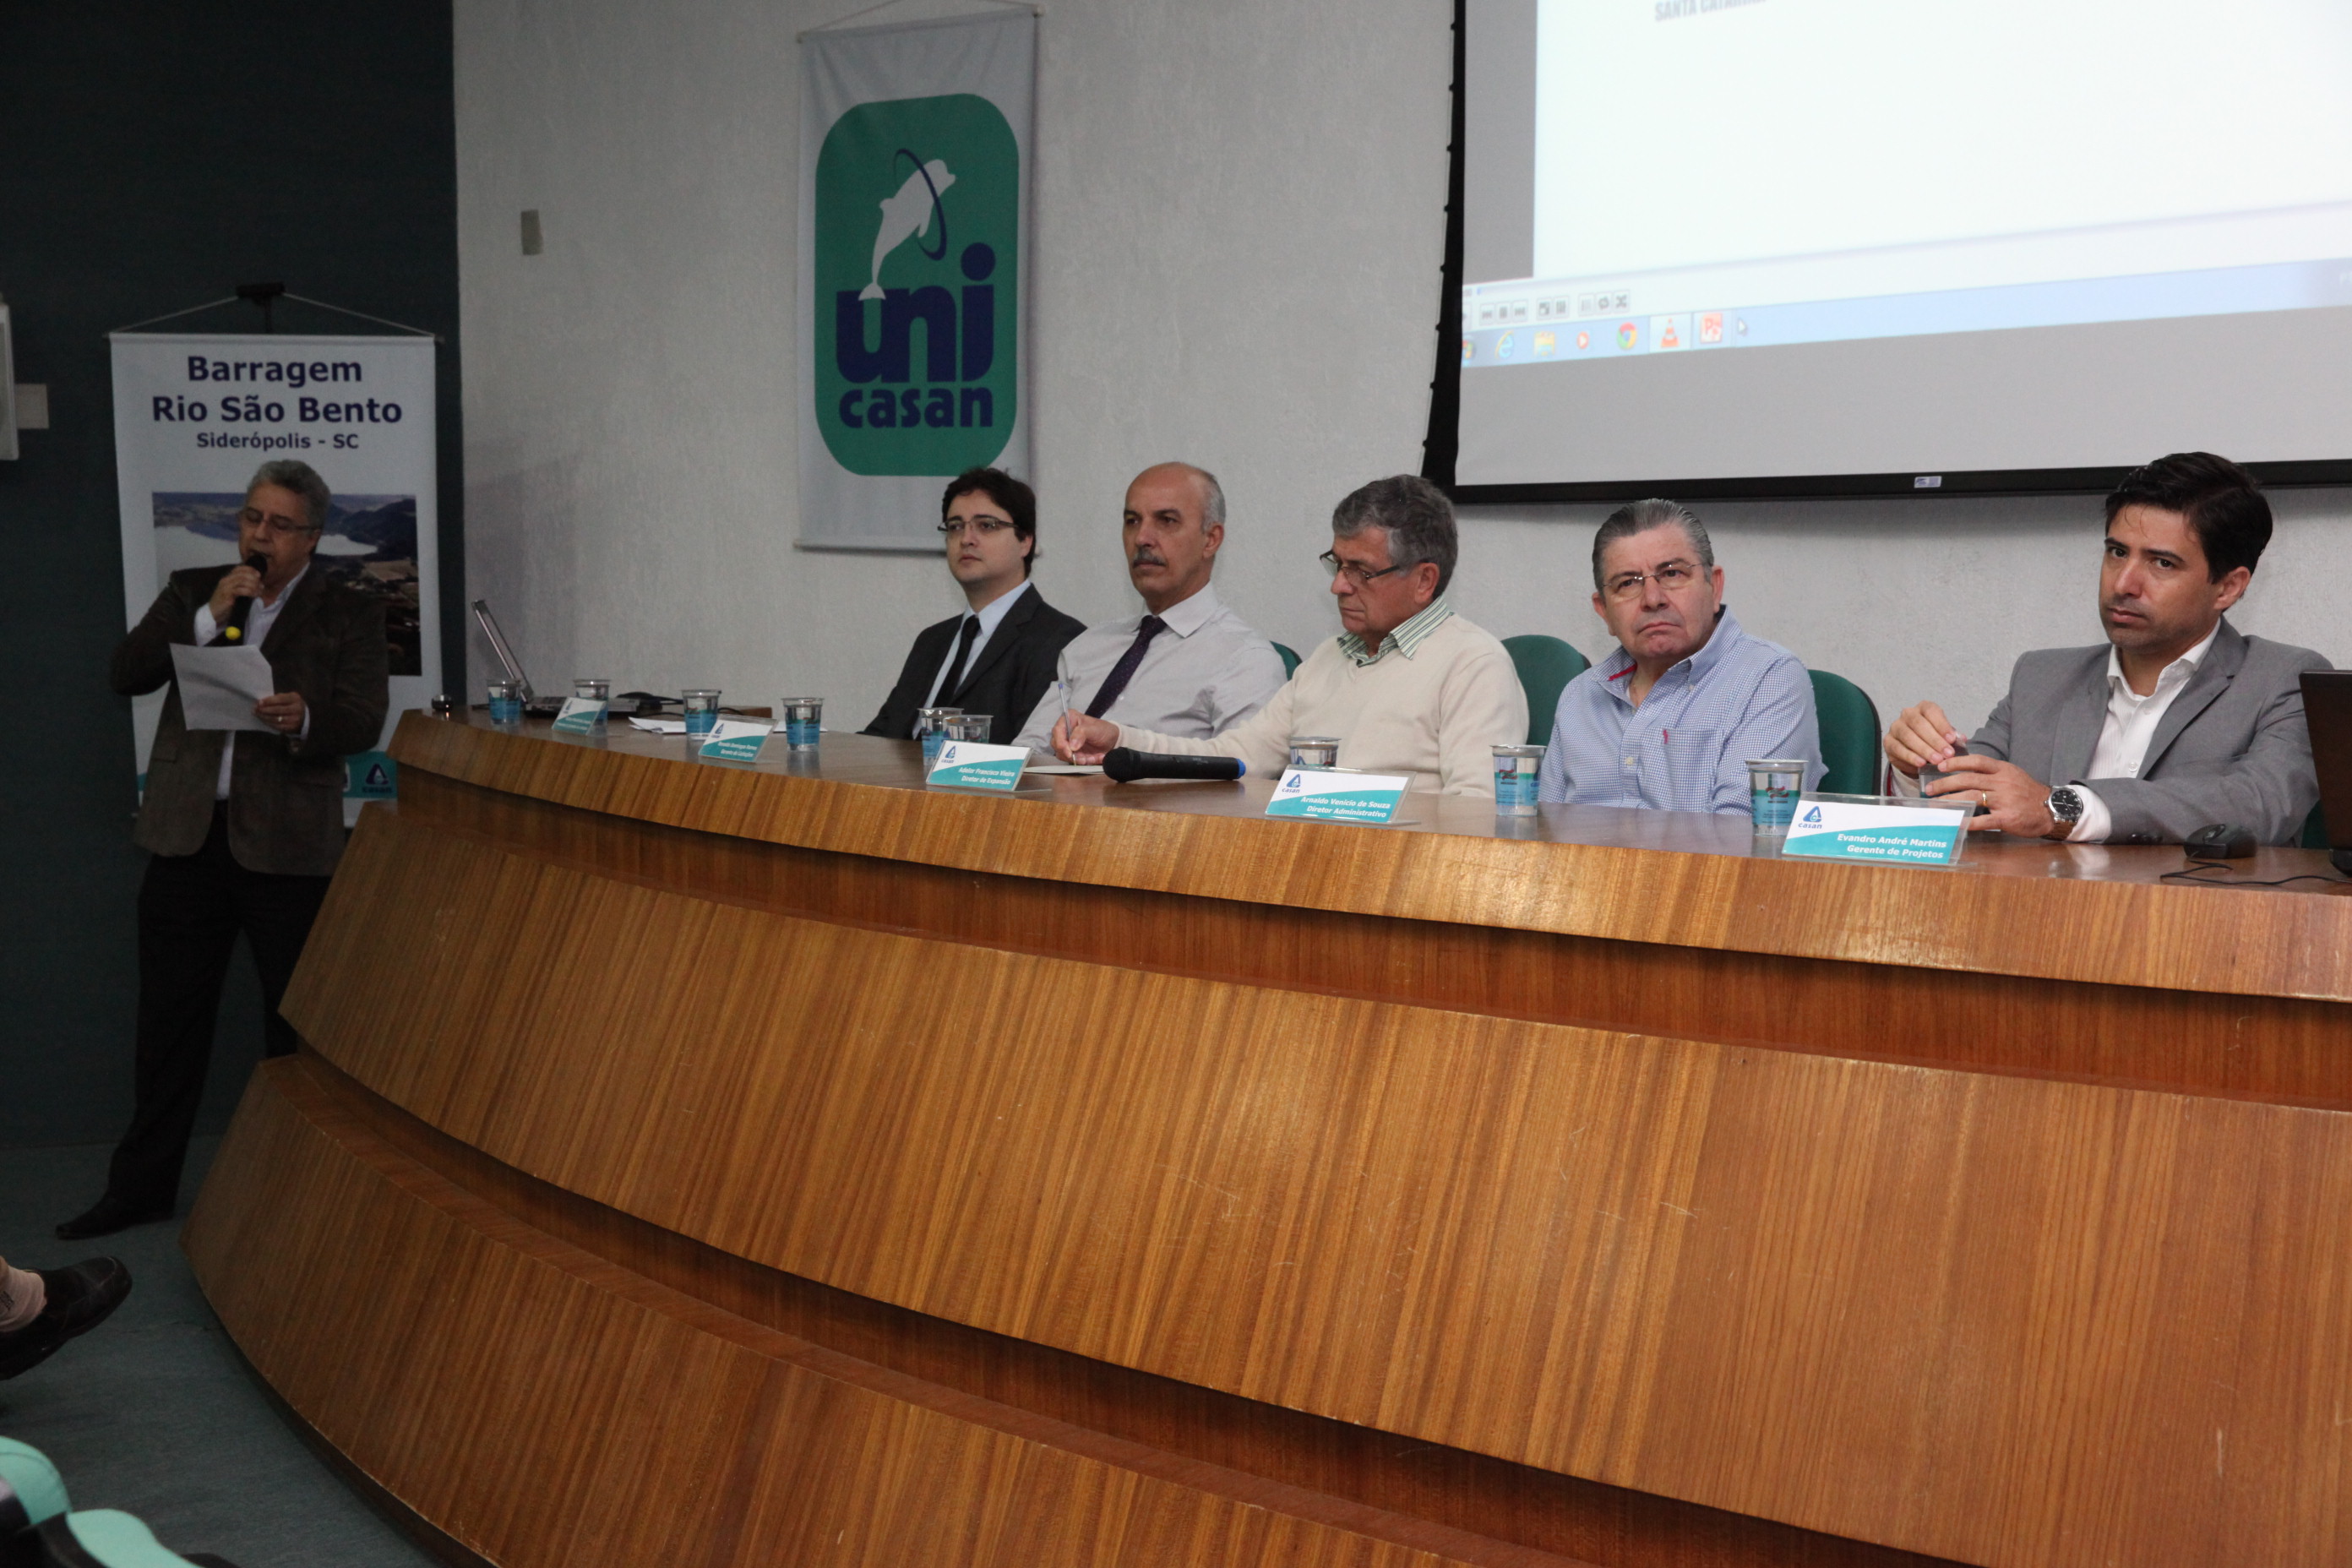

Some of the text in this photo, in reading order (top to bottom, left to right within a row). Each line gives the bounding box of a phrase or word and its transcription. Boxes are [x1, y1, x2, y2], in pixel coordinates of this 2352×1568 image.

[837, 242, 996, 383] uni
[188, 355, 362, 388] Barragem
[153, 395, 403, 423] Rio São Bento
[840, 388, 993, 428] casan
[196, 432, 312, 451] Siderópolis
[333, 434, 359, 449] SC
[1301, 796, 1329, 804] Arnaldo
[1307, 805, 1386, 818] Diretor Administrativo
[1838, 833, 1946, 848] Evandro André Martins
[1847, 844, 1944, 859] Gerente de Projetos
